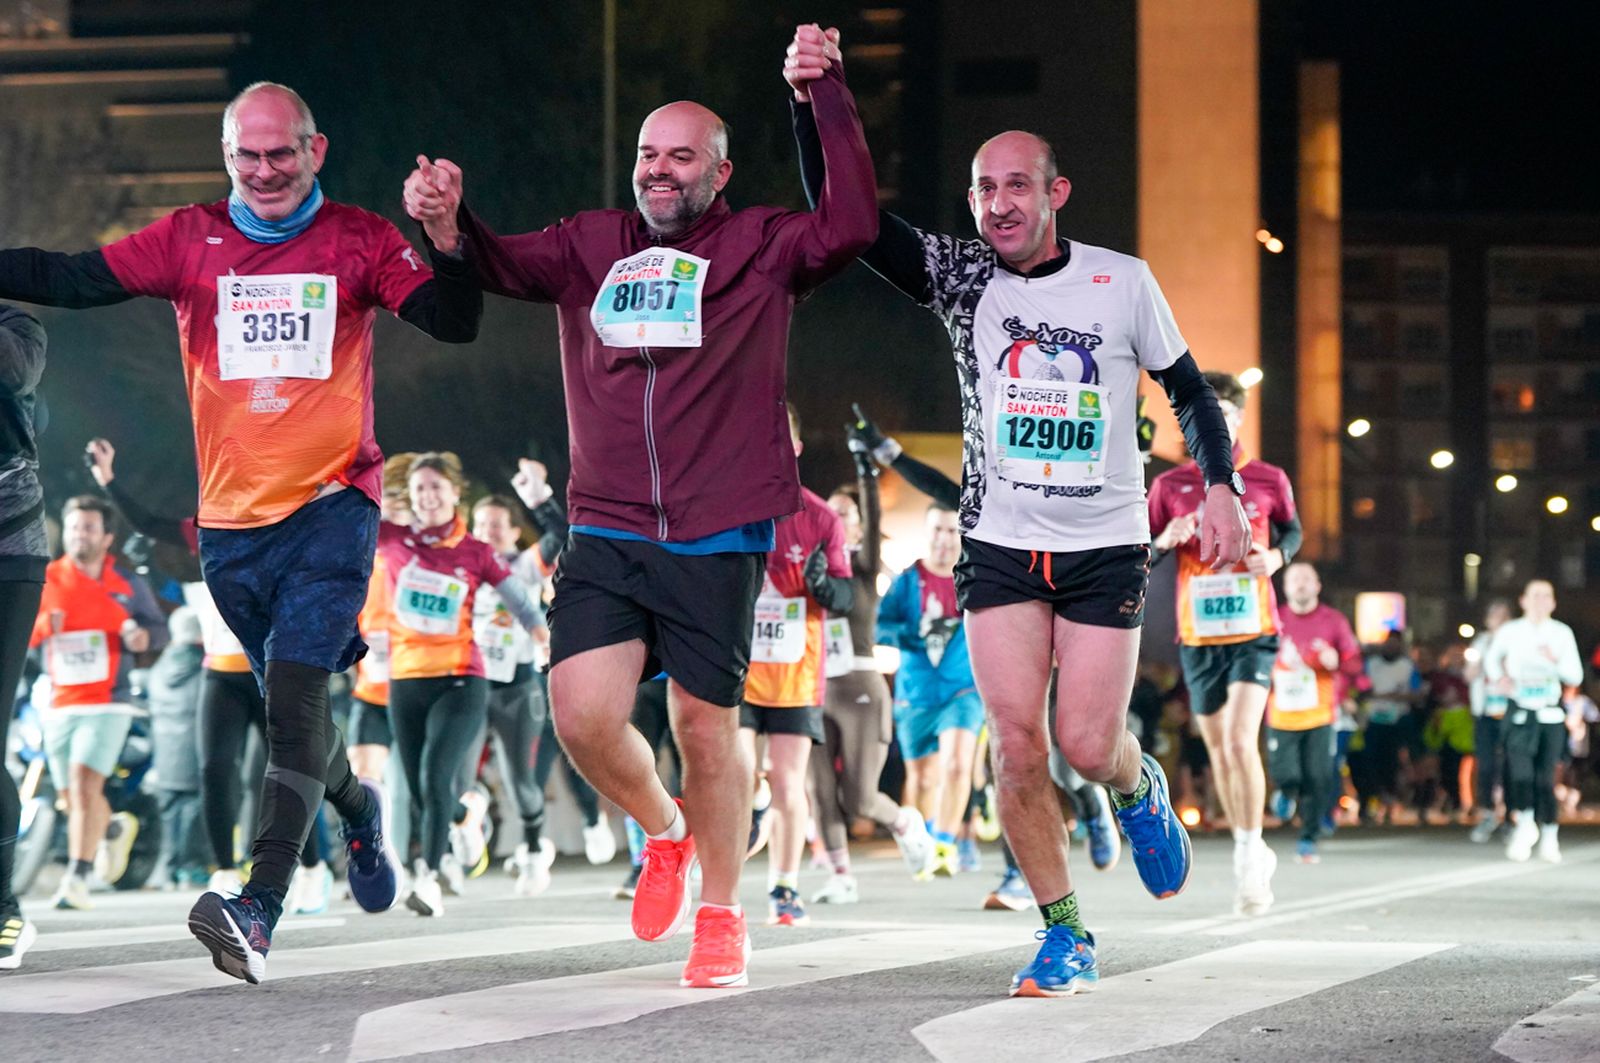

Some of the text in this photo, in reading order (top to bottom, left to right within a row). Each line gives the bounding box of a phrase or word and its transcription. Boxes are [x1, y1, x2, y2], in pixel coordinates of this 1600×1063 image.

[626, 257, 650, 272] NOCHE
[650, 257, 665, 267] DE
[611, 273, 630, 285] SAN
[244, 287, 276, 298] NOCHE
[278, 286, 292, 297] DE
[613, 280, 680, 313] 8057
[231, 300, 253, 312] SAN
[242, 311, 311, 344] 3351
[1019, 391, 1053, 403] NOCHE
[1055, 393, 1068, 404] DE
[1007, 402, 1028, 415] SAN
[1005, 416, 1096, 451] 12906
[1204, 595, 1246, 616] 8282
